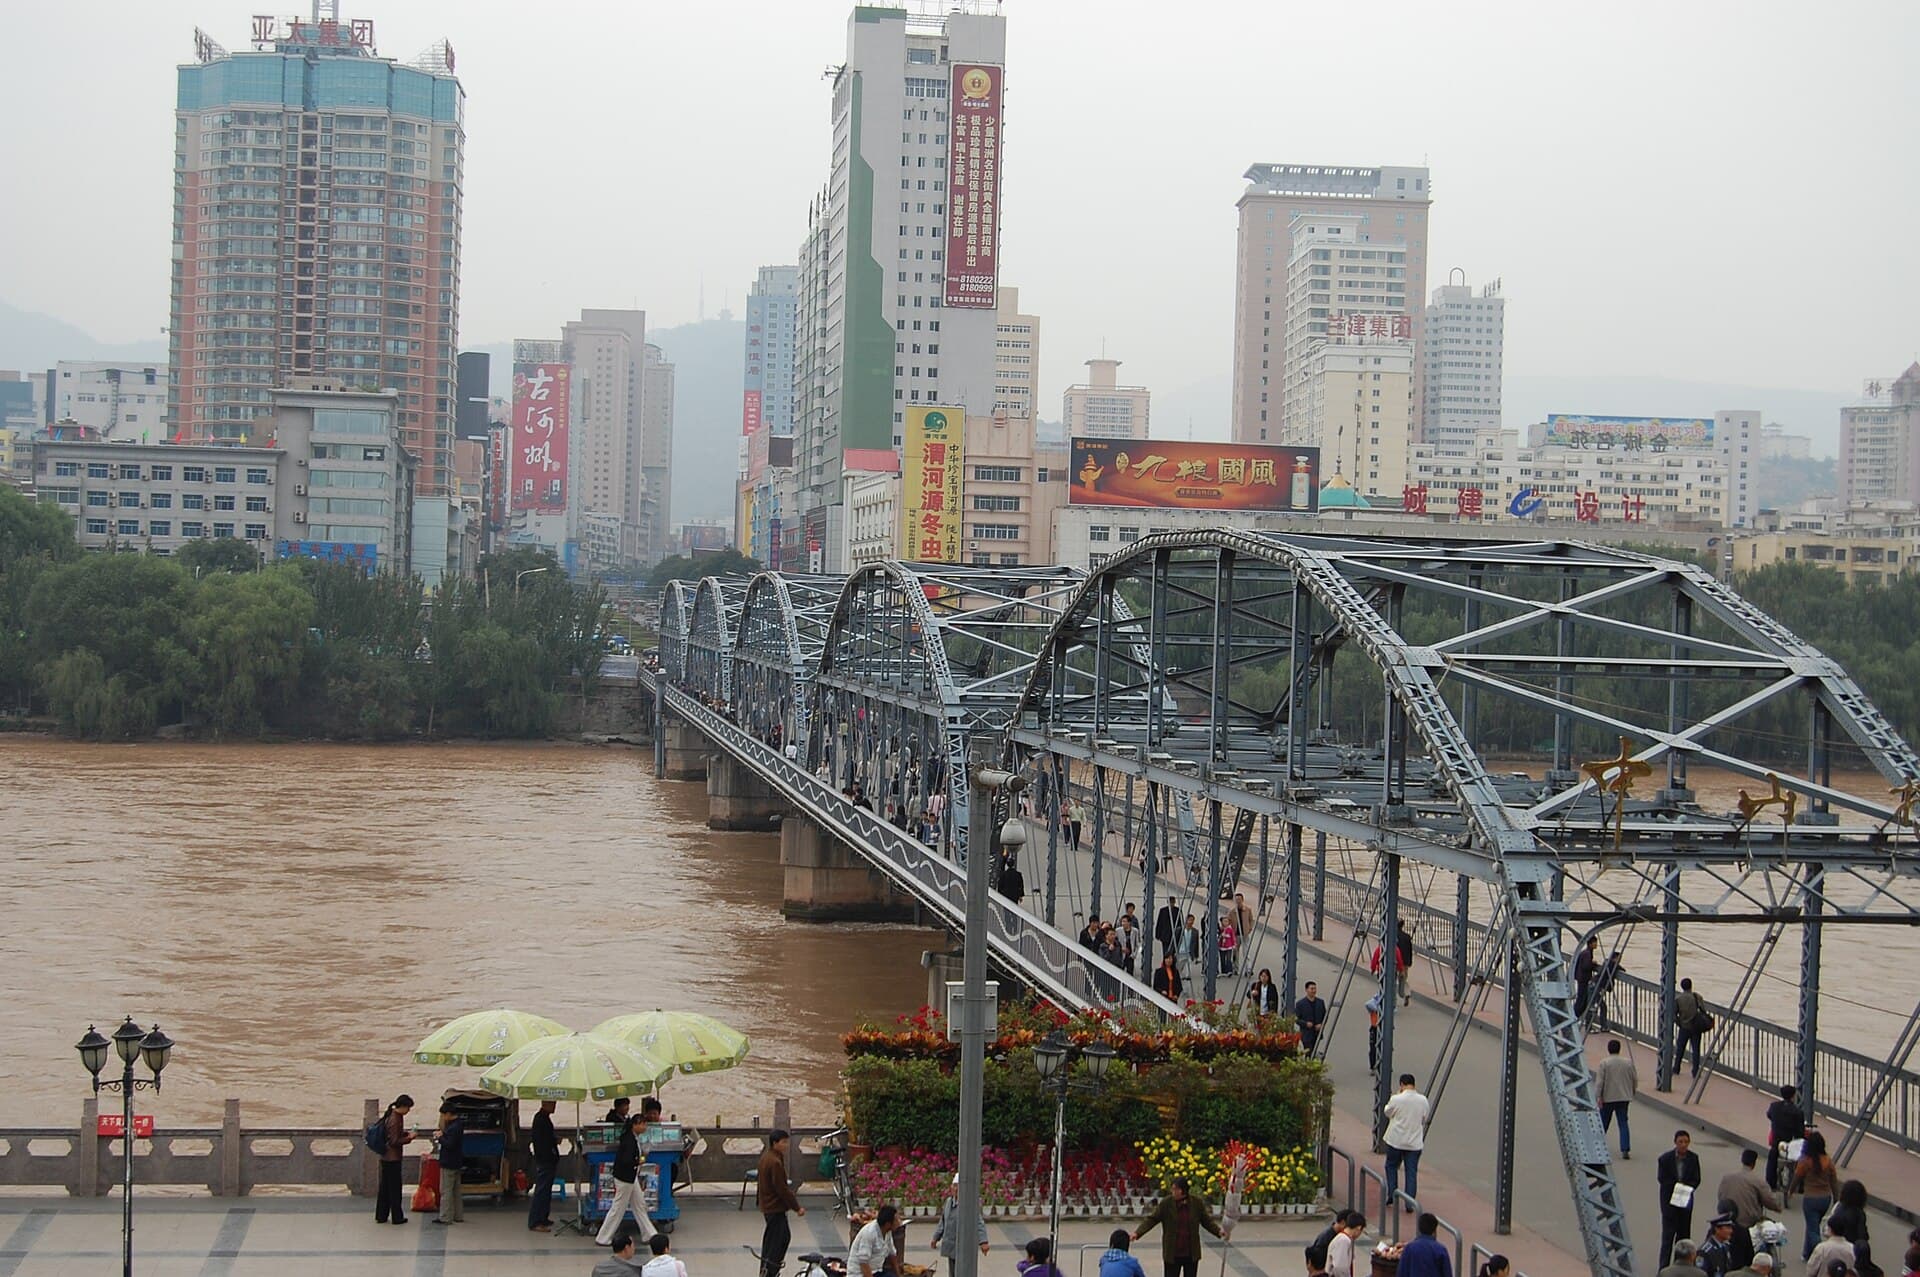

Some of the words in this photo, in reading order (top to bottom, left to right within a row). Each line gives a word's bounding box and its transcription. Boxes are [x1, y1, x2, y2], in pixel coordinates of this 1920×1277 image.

[102, 1117, 149, 1127] 天下黄一桥
